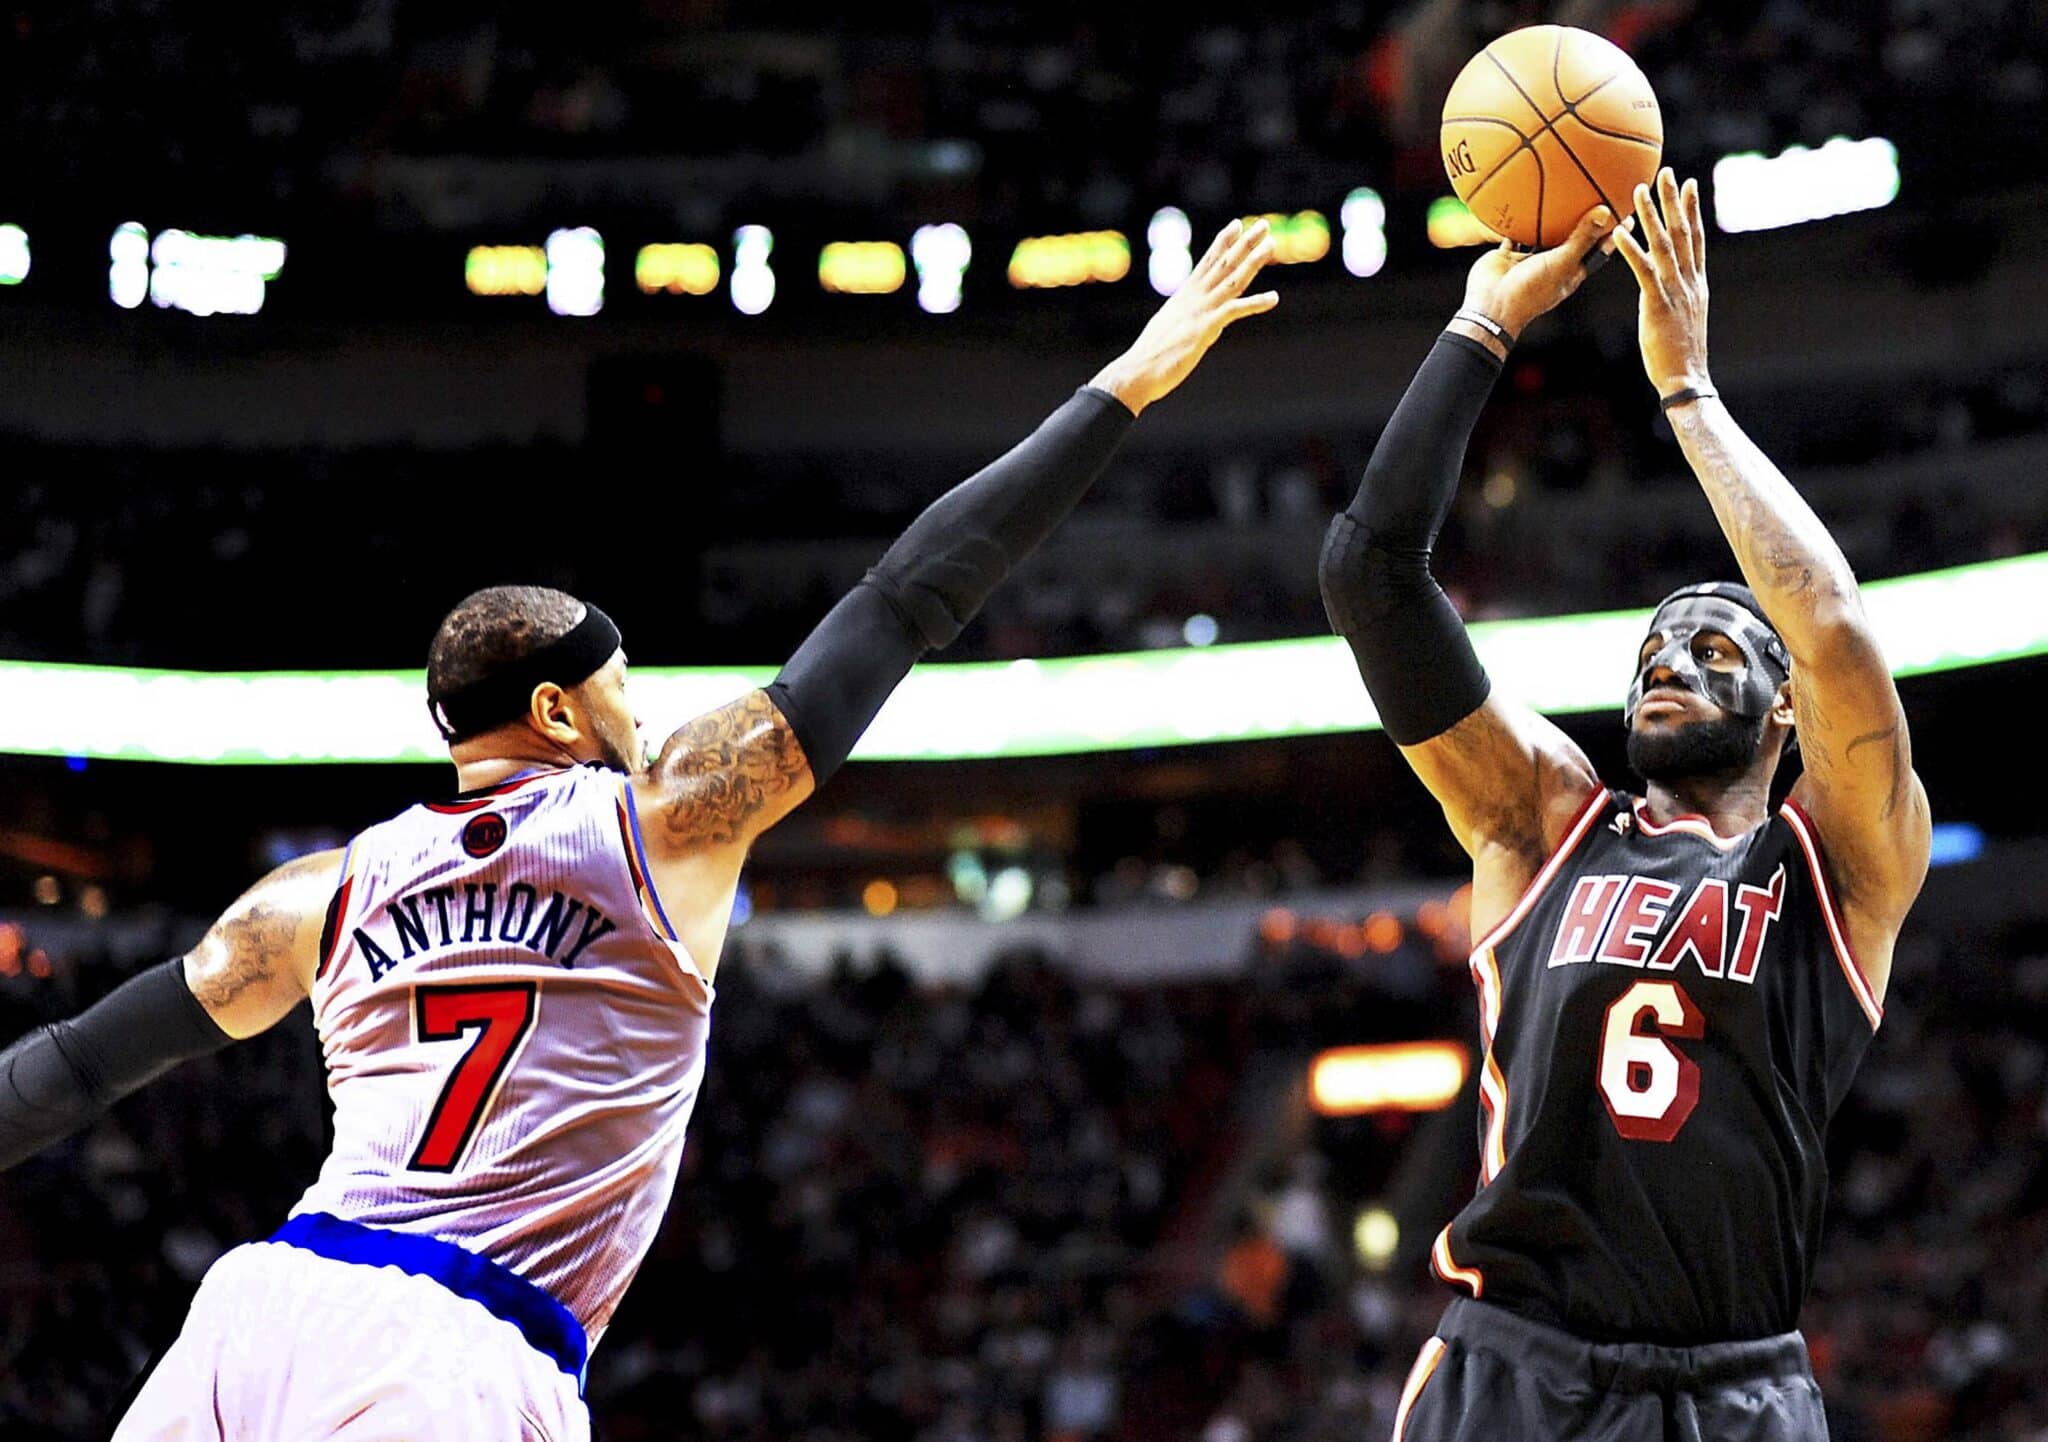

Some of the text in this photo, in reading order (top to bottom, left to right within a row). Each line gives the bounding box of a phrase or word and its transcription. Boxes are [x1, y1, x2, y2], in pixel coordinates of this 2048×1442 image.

[352, 882, 616, 983] ANTHONY
[1548, 862, 1786, 984] HEAT
[406, 982, 540, 1174] 7
[1596, 978, 1705, 1142] 6
